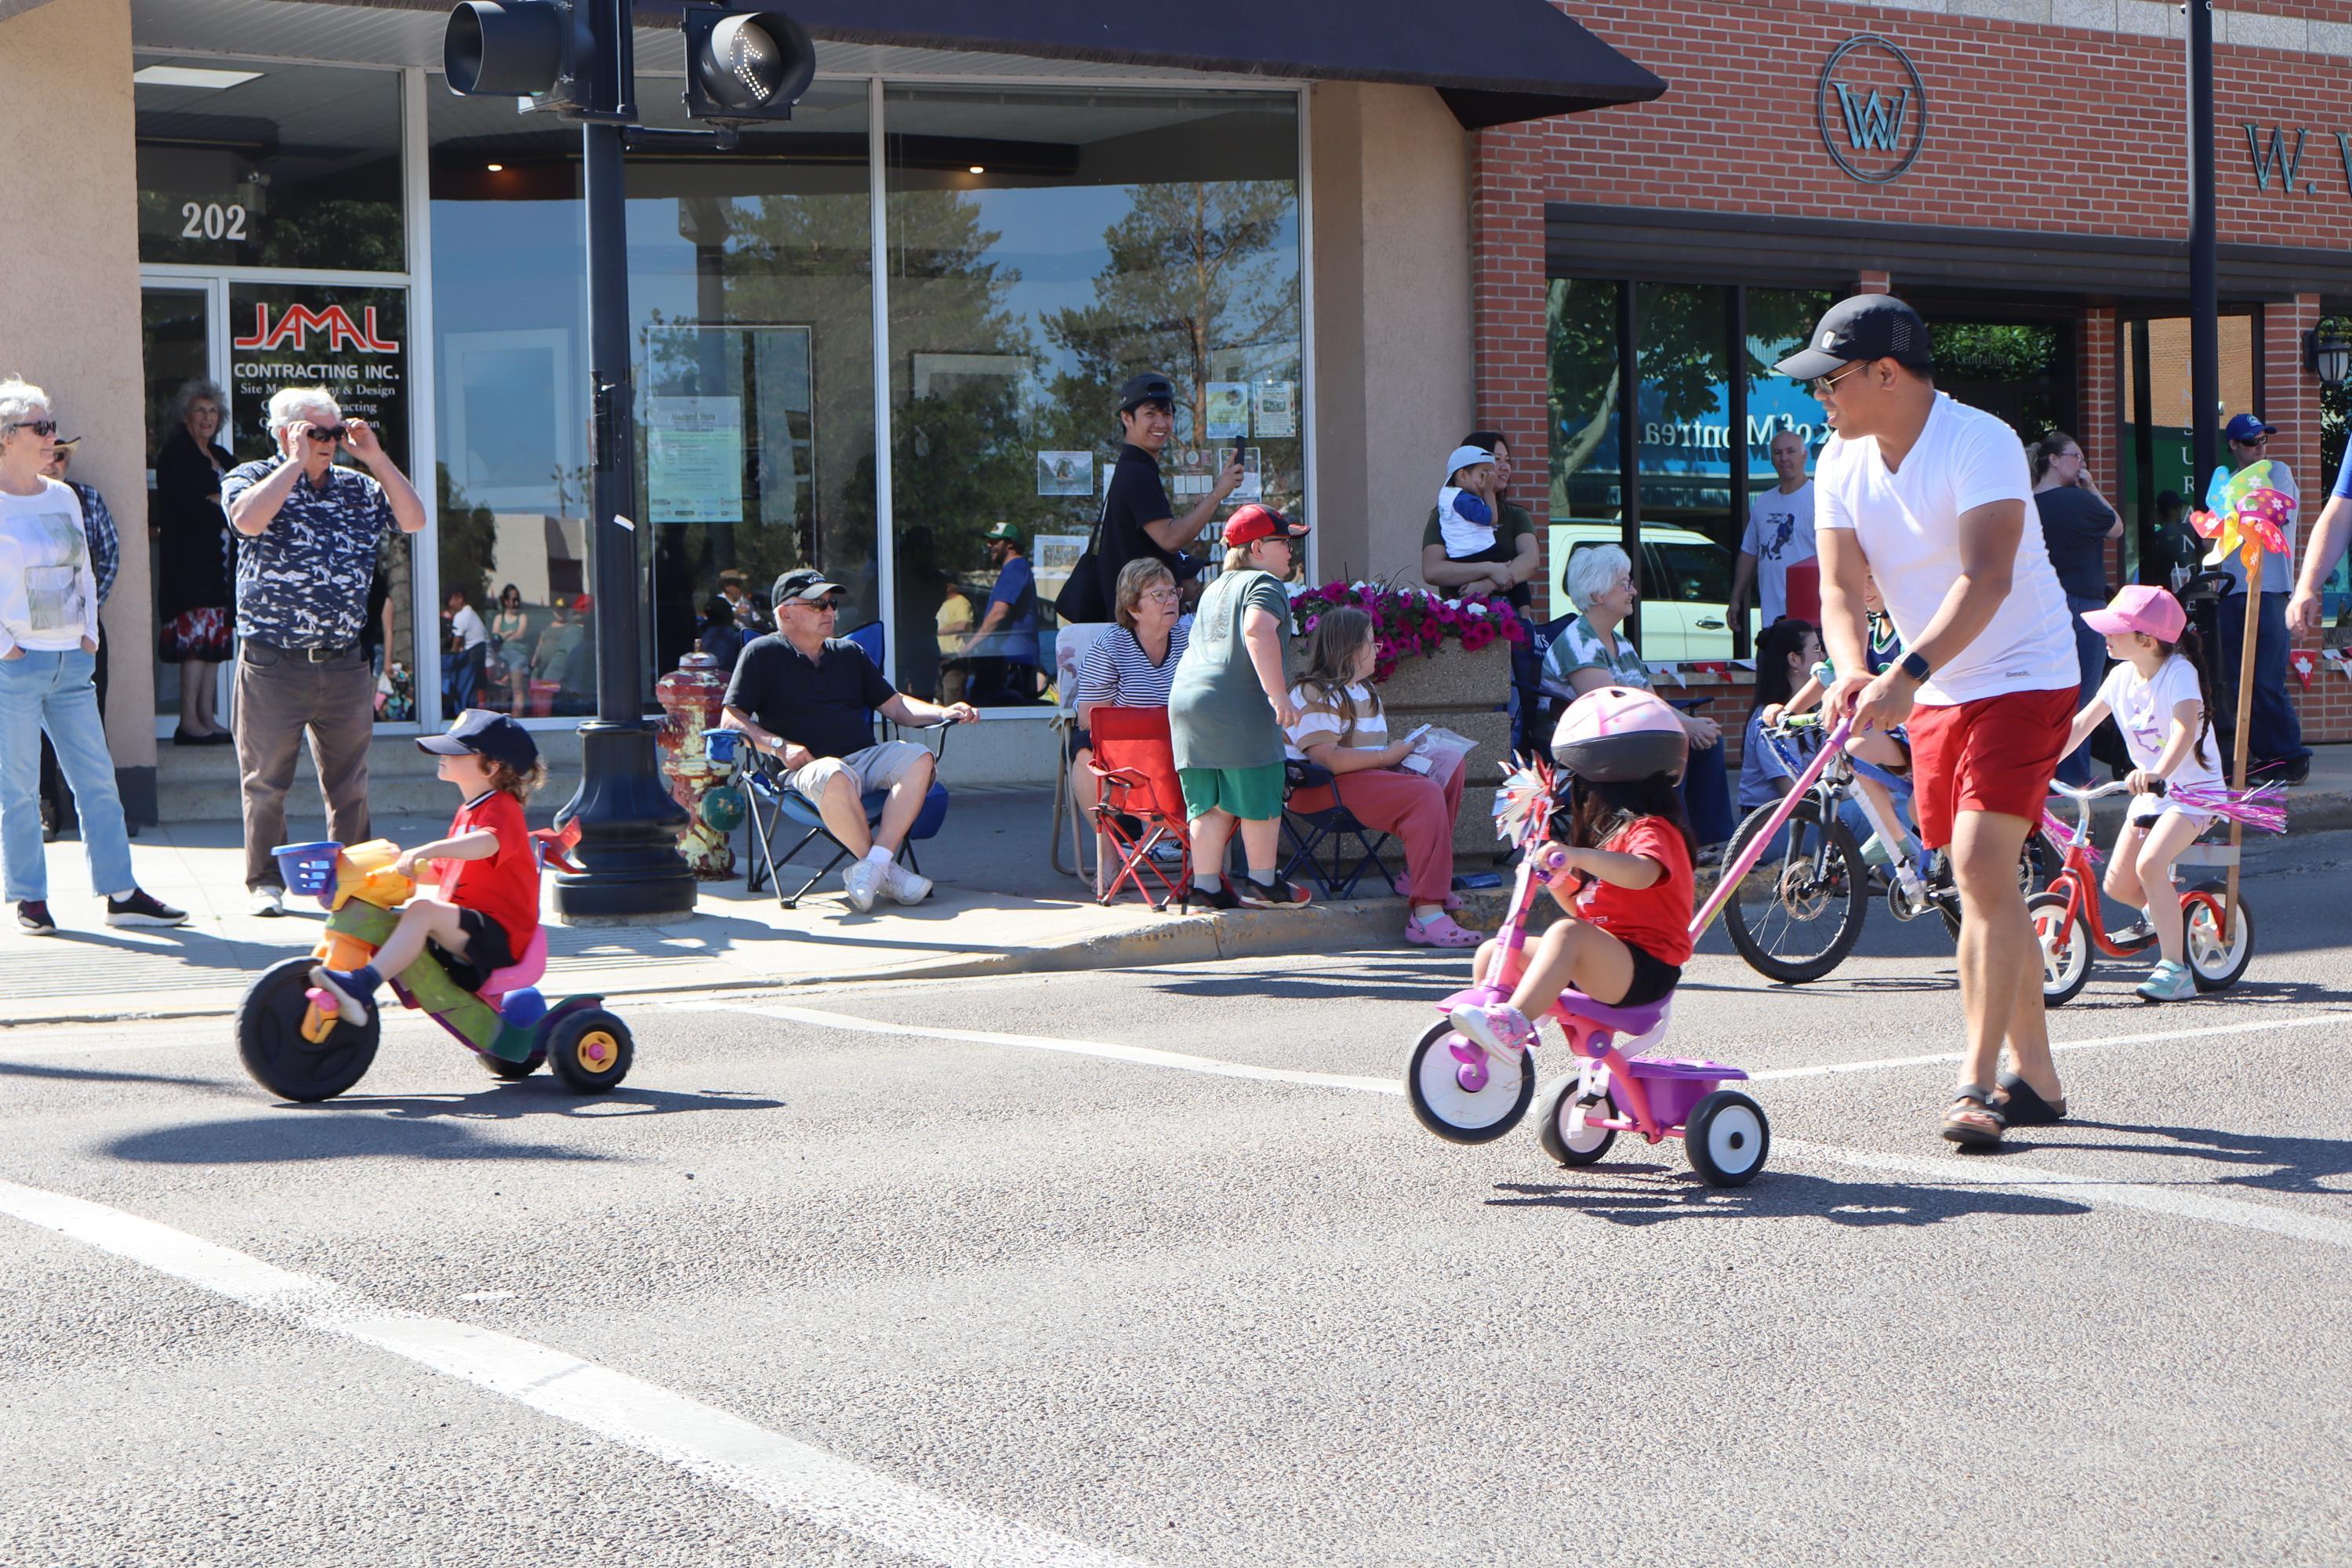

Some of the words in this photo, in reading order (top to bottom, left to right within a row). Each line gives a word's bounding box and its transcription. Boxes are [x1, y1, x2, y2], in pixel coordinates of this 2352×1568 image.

[182, 201, 247, 241] 202
[234, 303, 399, 353] JAMAL
[234, 363, 358, 379] CONTRACTING
[365, 365, 400, 380] INC.
[241, 383, 263, 395] Site
[343, 386, 353, 395] &
[356, 386, 396, 398] Design
